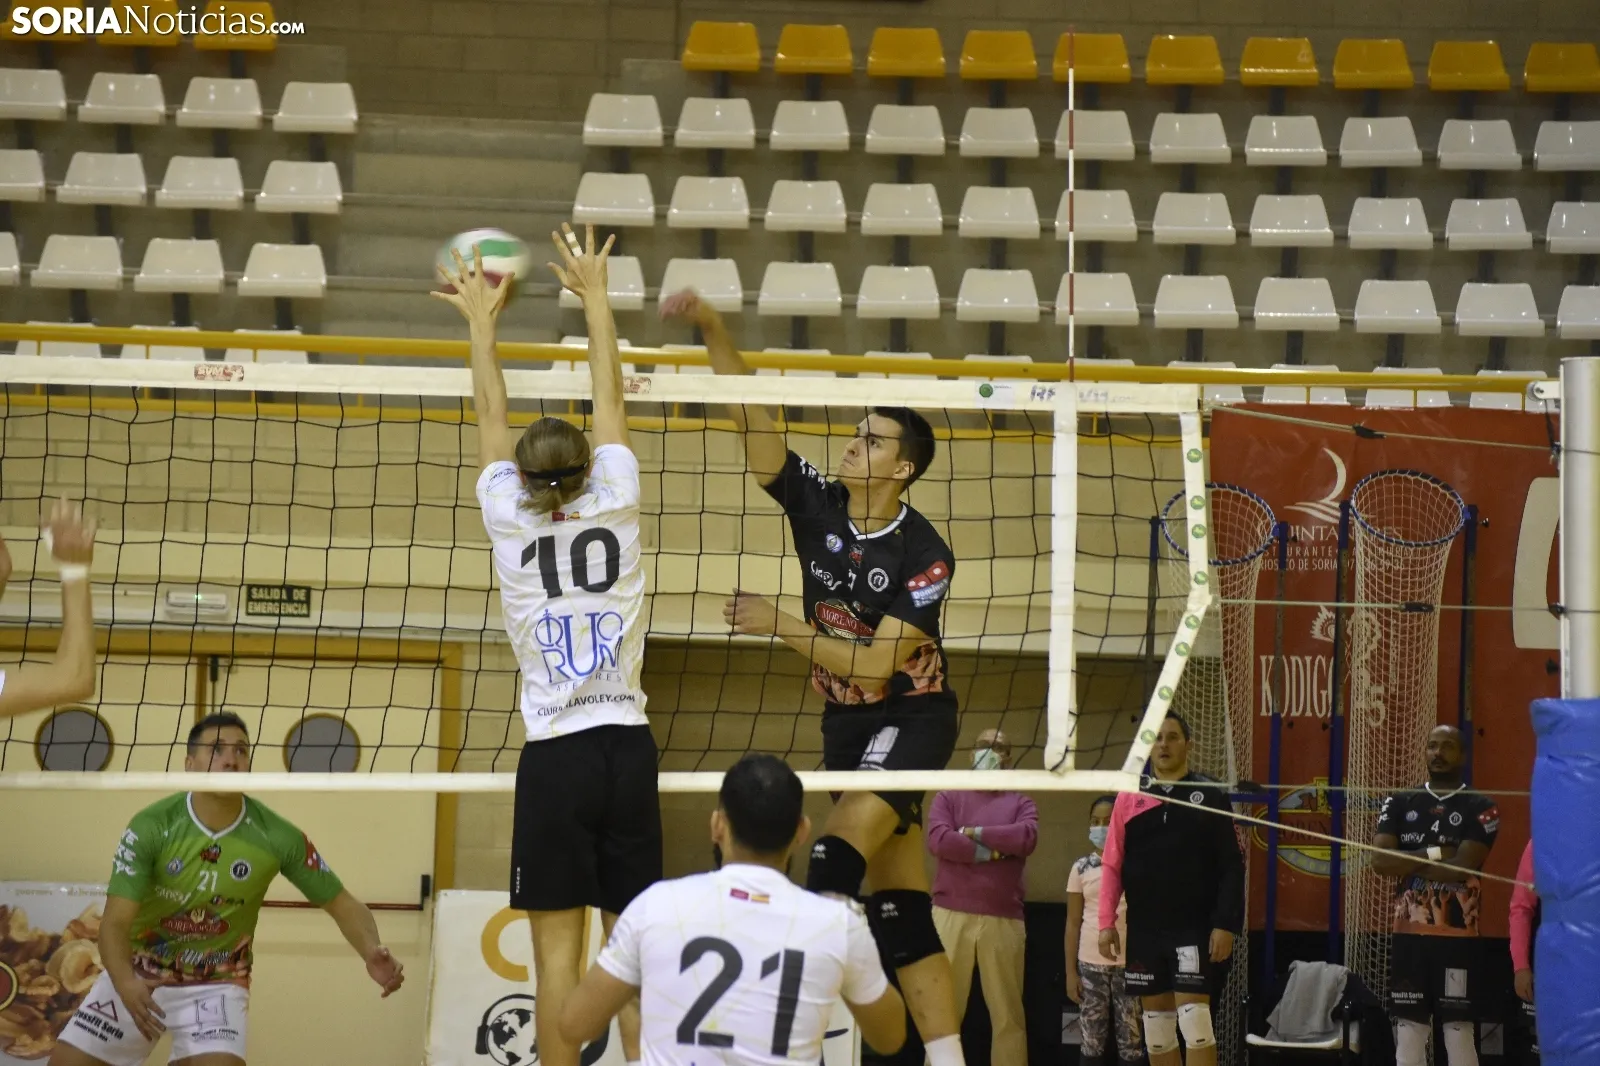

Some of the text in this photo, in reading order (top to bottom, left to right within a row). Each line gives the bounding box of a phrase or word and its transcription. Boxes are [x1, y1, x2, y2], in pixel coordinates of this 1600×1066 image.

[520, 526, 621, 599] 10
[1298, 558, 1309, 571] DE
[1311, 558, 1337, 571] SORIA
[250, 587, 307, 601] SALIDA DE
[247, 602, 309, 615] EMERGENCIA
[822, 608, 857, 630] MORENO
[1430, 820, 1440, 833] 4
[197, 869, 218, 892] 21
[675, 935, 806, 1058] 21
[101, 1020, 124, 1040] Soria
